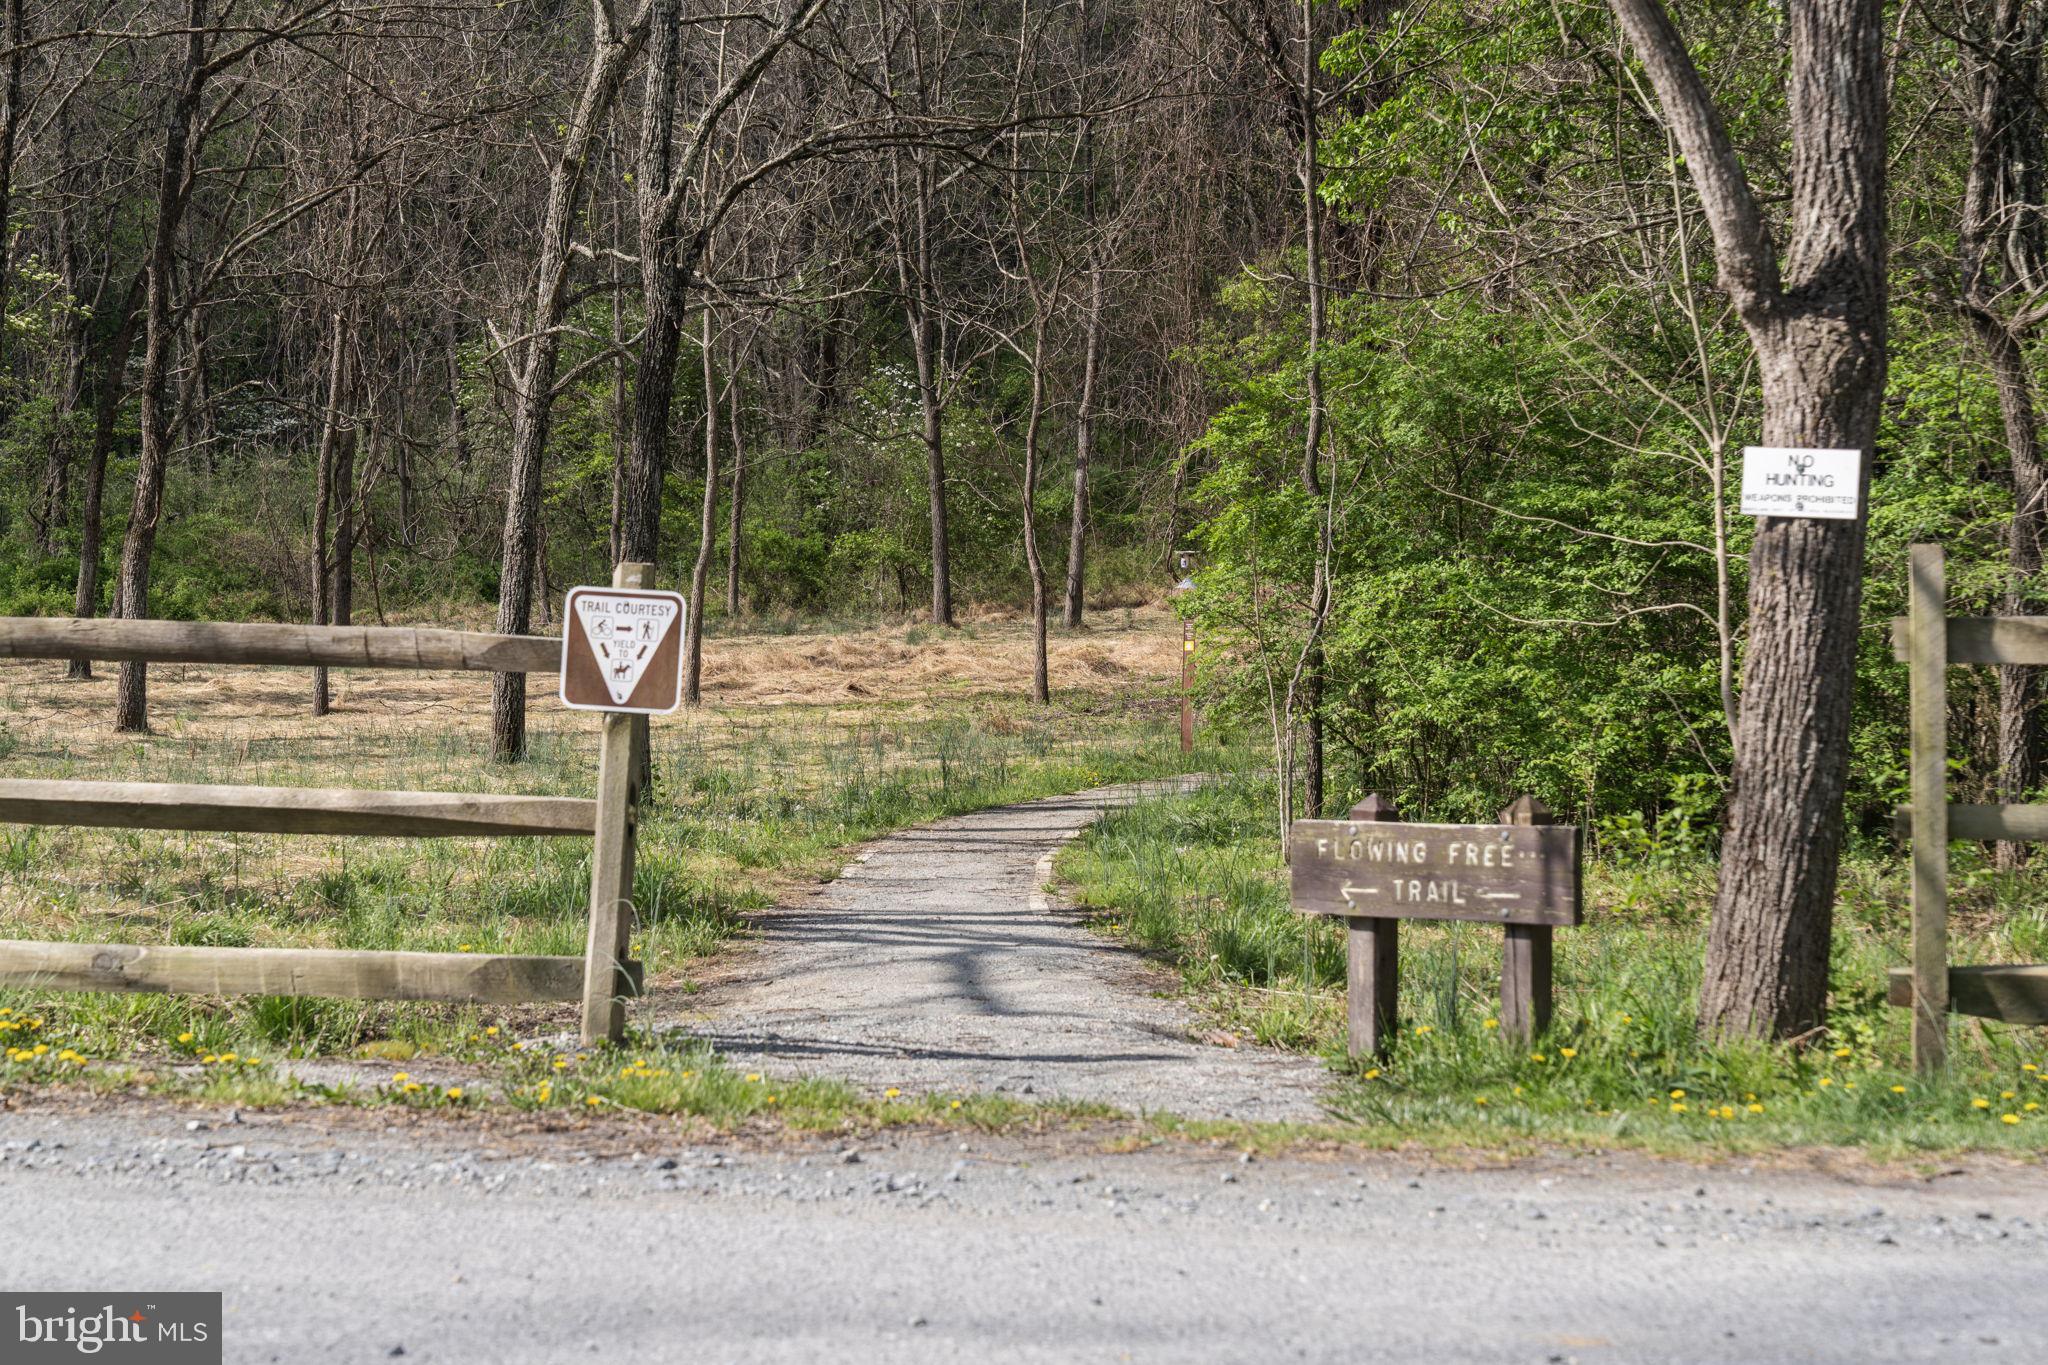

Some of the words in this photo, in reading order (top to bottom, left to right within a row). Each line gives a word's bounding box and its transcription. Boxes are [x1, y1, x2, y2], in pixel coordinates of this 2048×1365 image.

[1788, 455, 1815, 468] NO
[1766, 473, 1834, 487] HUNTING
[1745, 494, 1792, 502] WEAPONS
[582, 601, 611, 613] TRAIL
[615, 603, 671, 616] COURTESY
[613, 640, 635, 649] YIELD
[1317, 839, 1427, 863] FLOWING
[1393, 879, 1467, 904] TRAIL
